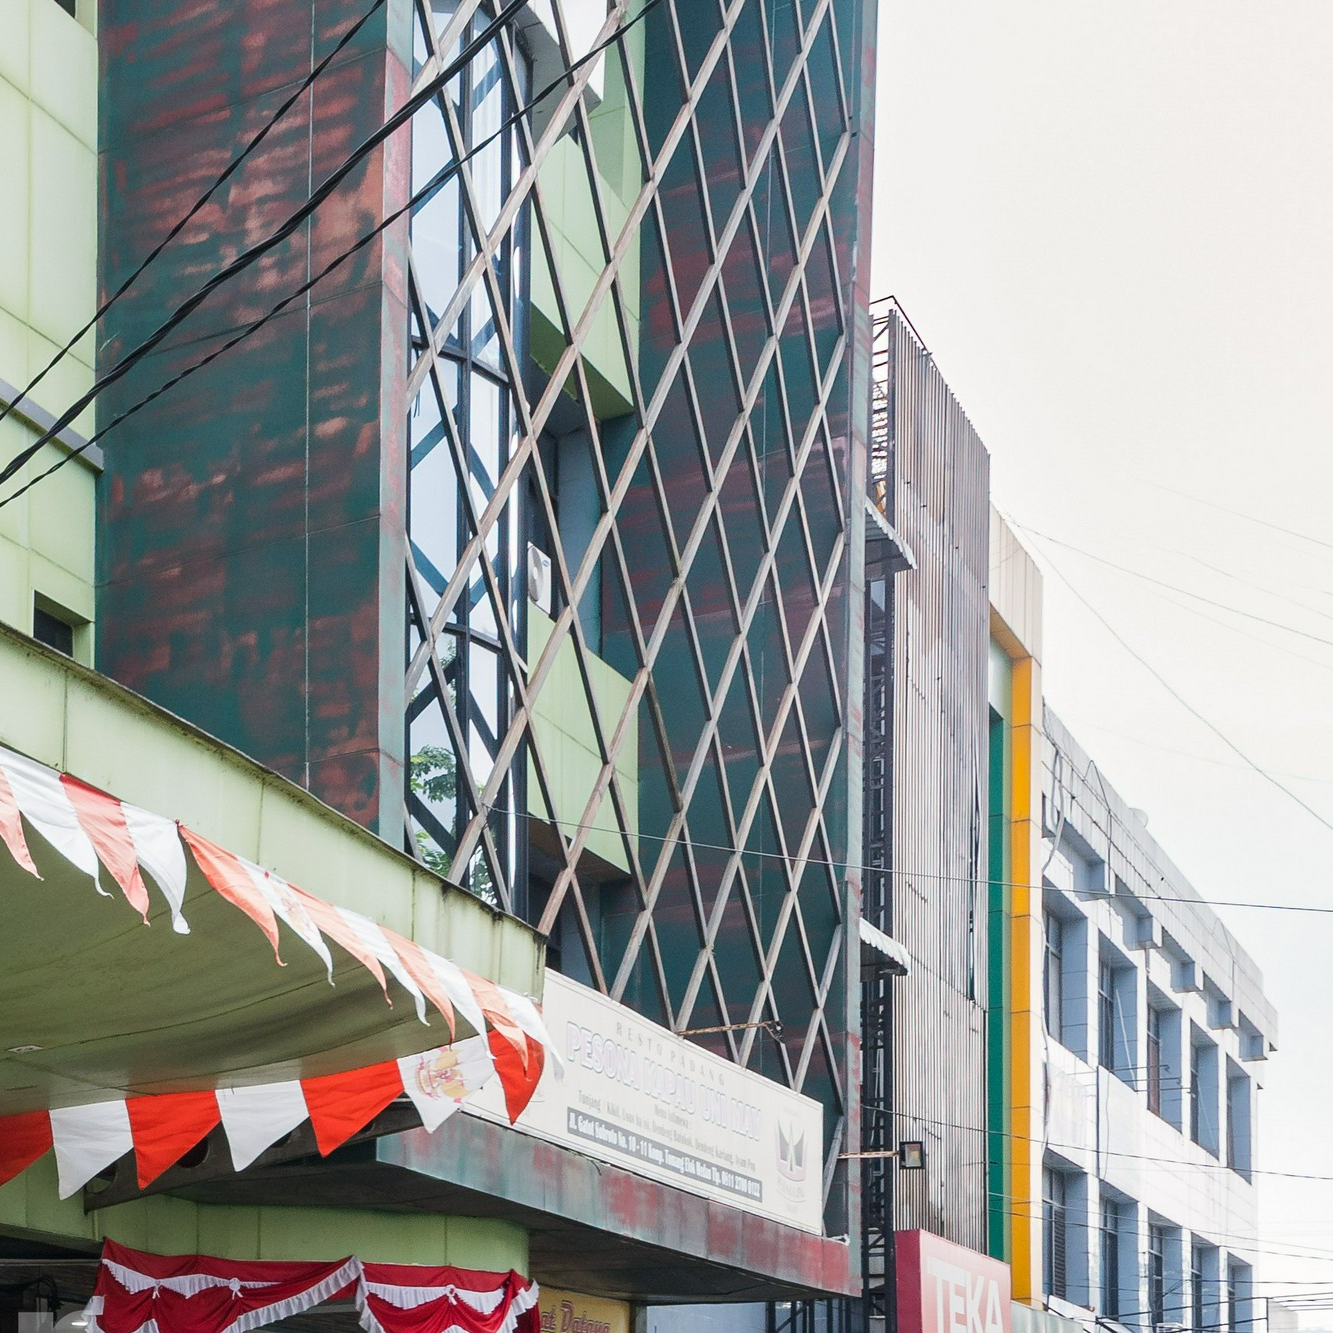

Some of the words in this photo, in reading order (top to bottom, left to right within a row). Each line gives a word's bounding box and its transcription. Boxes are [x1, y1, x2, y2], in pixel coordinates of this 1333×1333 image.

[566, 1021, 640, 1091] PESONA
[616, 1022, 663, 1056] RESTO
[670, 1049, 725, 1086] PADANG
